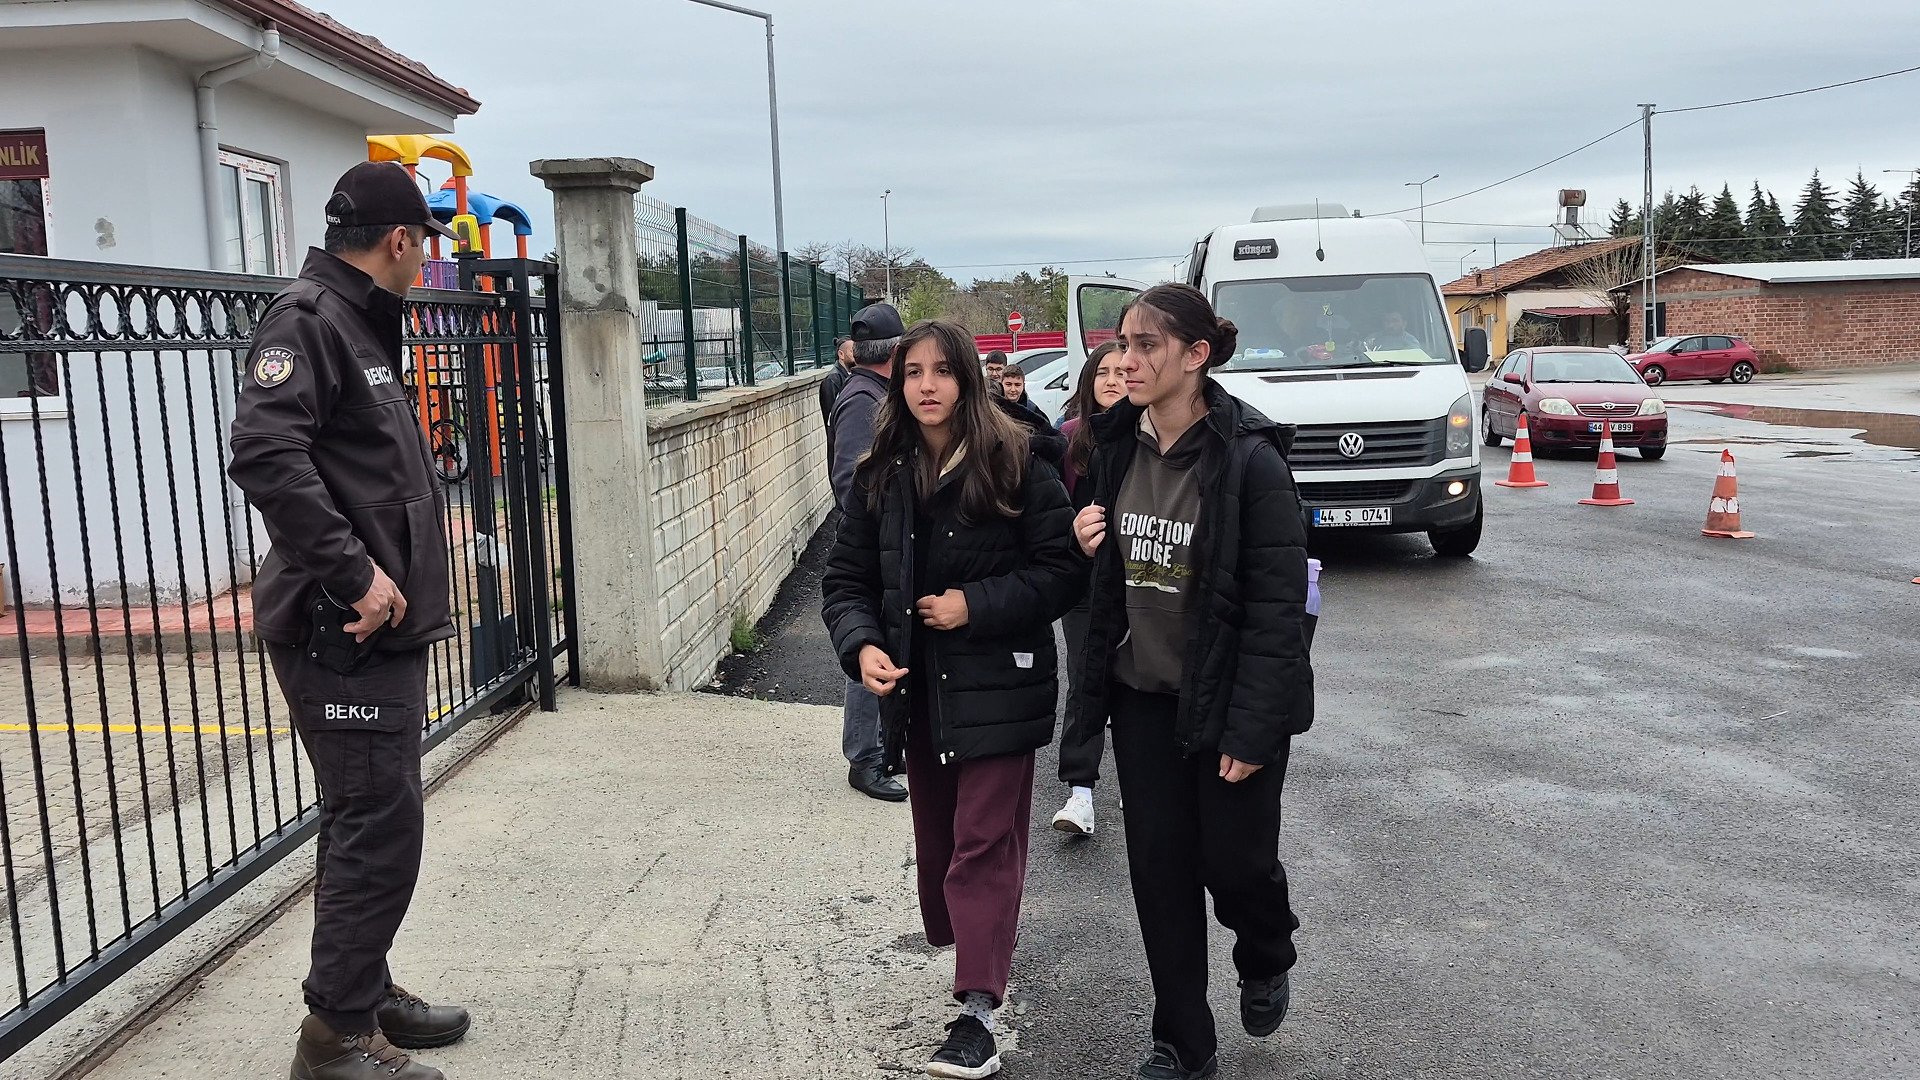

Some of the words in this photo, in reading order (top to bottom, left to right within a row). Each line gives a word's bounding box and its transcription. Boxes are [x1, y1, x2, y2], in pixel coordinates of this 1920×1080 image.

[1238, 244, 1272, 256] KÜRŞAT
[1617, 423, 1632, 431] 899
[1320, 510, 1335, 523] 44
[1344, 509, 1352, 522] S
[1361, 508, 1389, 522] 0741
